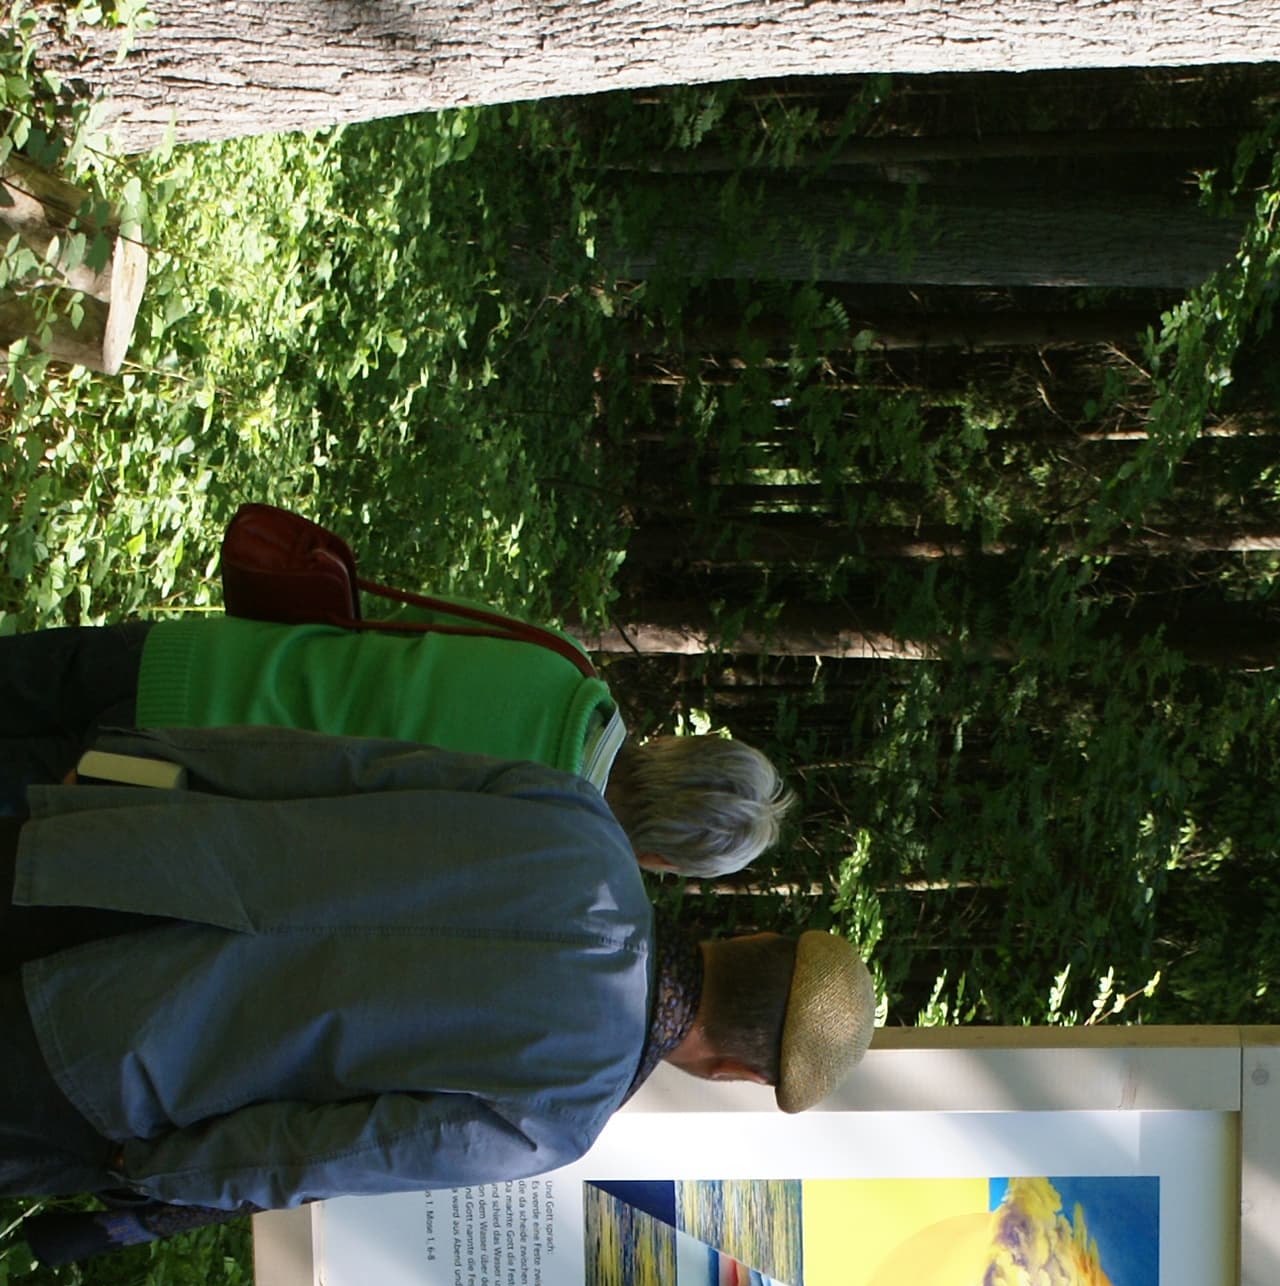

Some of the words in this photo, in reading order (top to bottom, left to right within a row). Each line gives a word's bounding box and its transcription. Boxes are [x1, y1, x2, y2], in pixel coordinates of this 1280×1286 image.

[505, 1181, 512, 1192] Da
[532, 1181, 539, 1190] Es
[545, 1181, 554, 1198] Und
[452, 1196, 461, 1218] ward
[519, 1197, 526, 1208] da
[546, 1202, 554, 1221] Gott
[426, 1211, 434, 1234] Mose
[506, 1230, 515, 1249] Gott
[545, 1224, 554, 1255] sprach:
[454, 1238, 462, 1266] Abend
[481, 1255, 489, 1274] über
